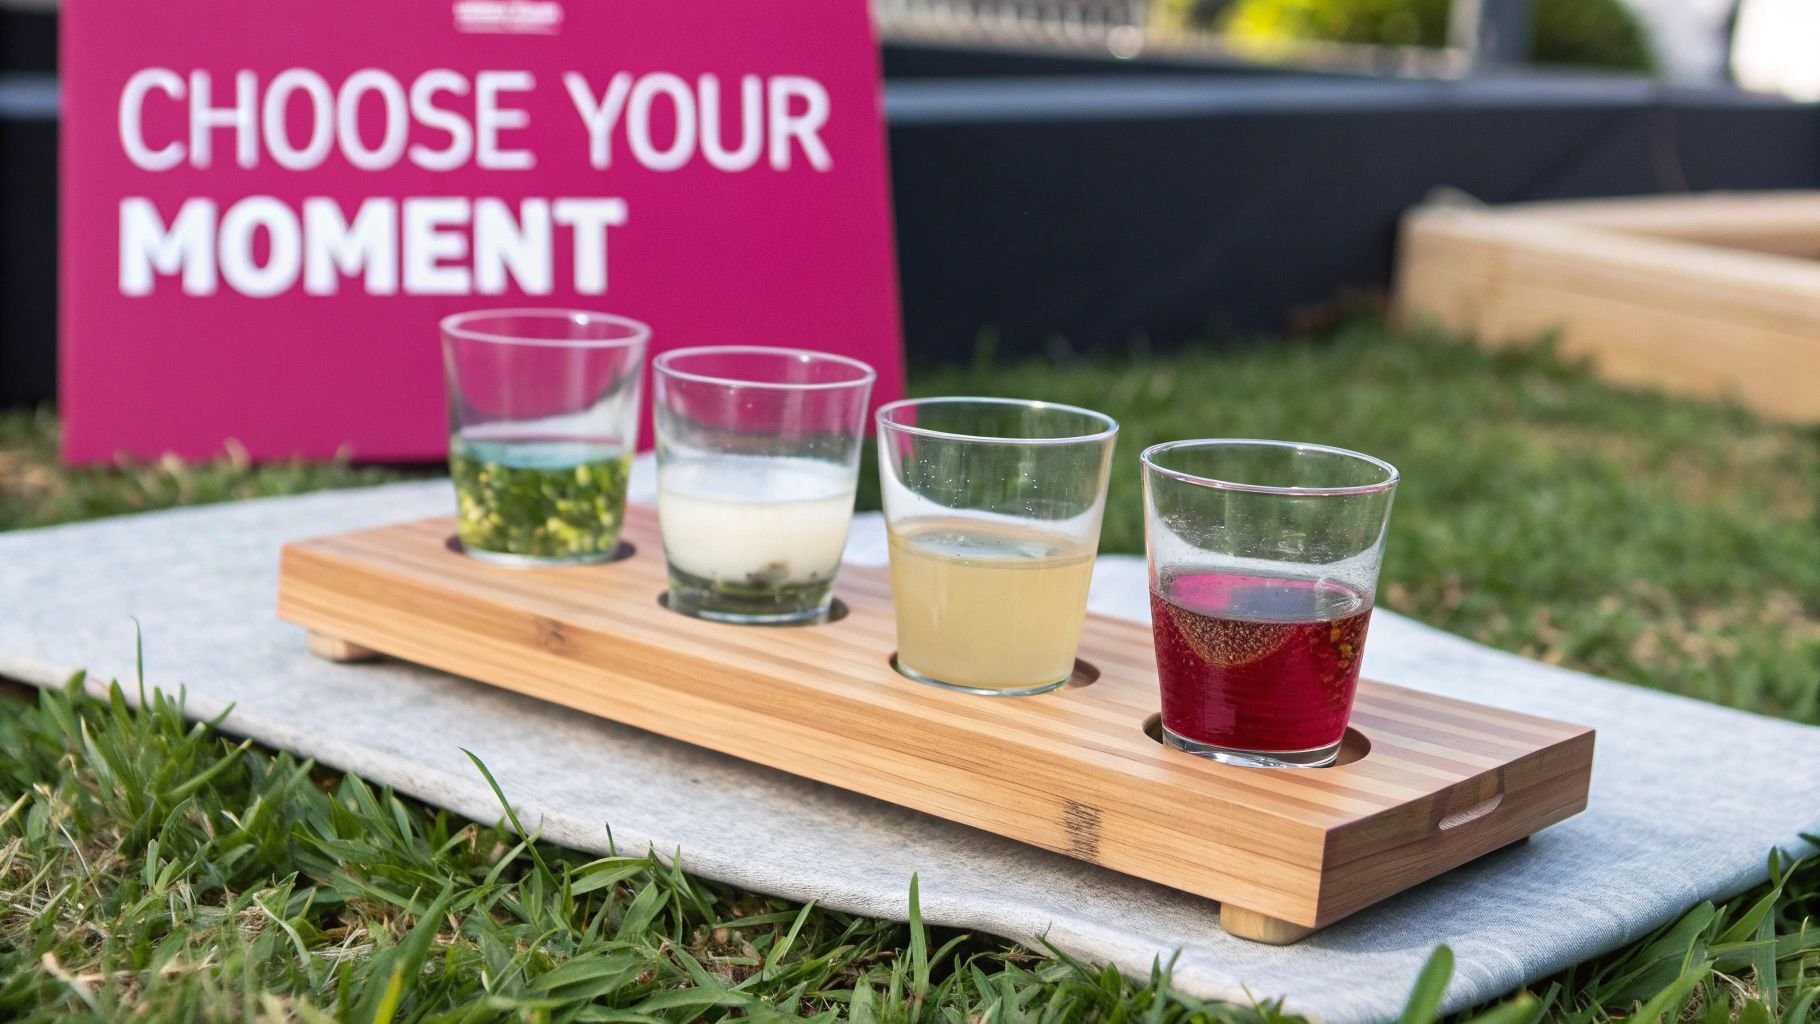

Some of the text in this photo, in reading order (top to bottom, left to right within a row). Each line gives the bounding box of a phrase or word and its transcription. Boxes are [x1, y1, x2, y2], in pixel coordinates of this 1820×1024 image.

[118, 67, 833, 173] CHOOSE YOUR
[118, 195, 628, 298] MOMENT
